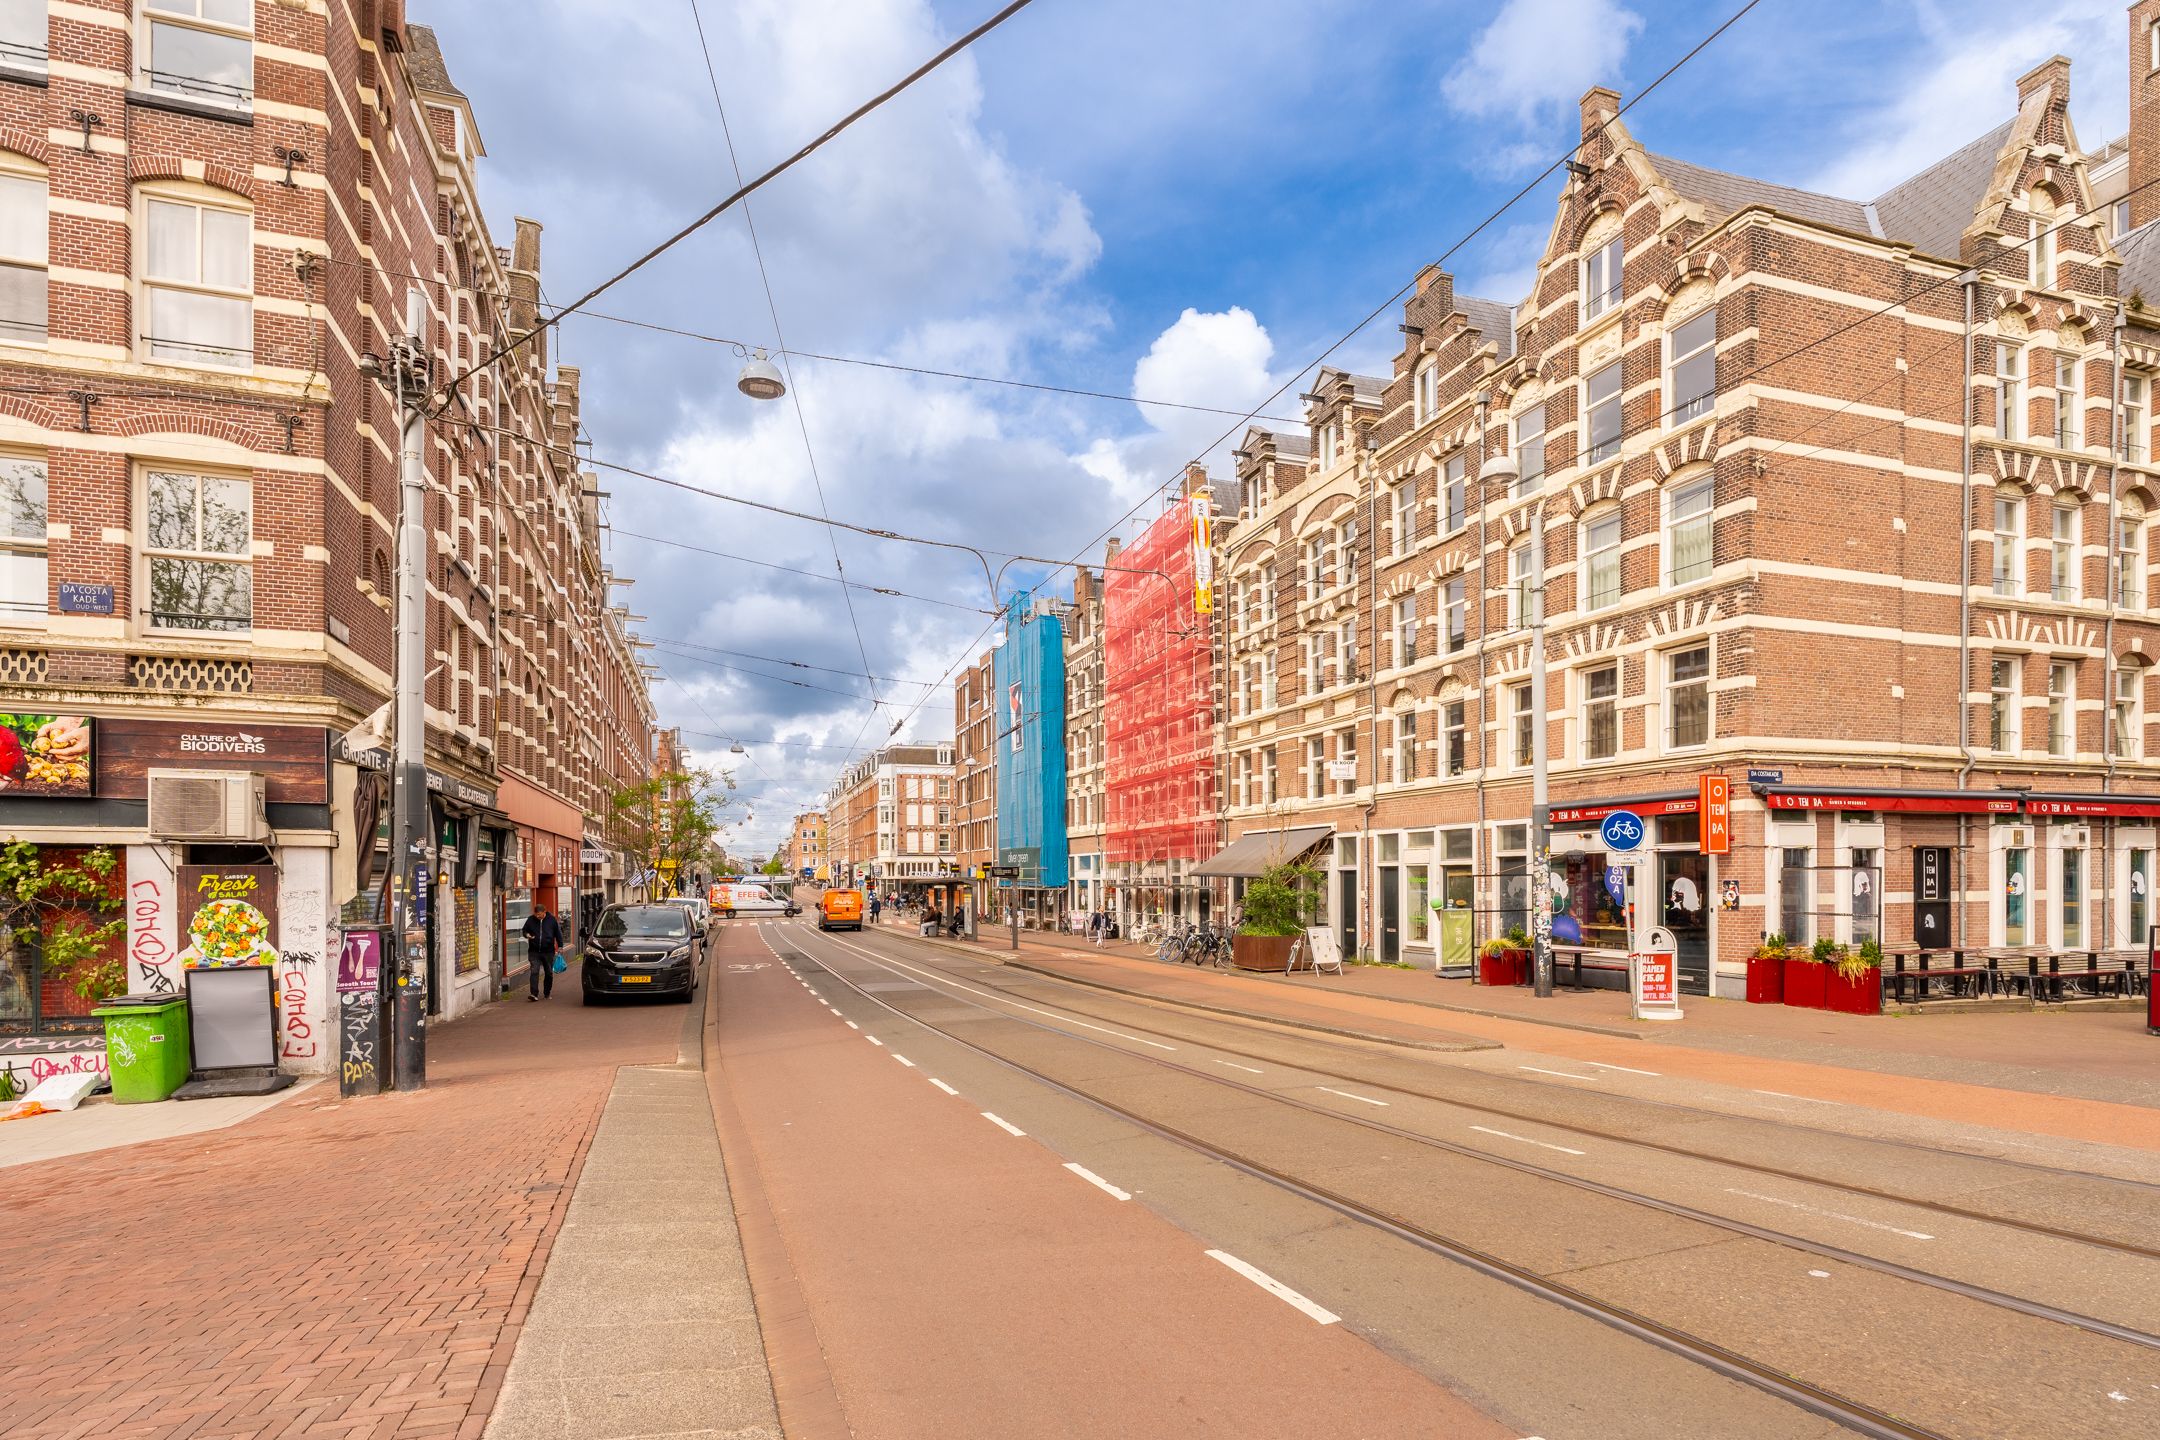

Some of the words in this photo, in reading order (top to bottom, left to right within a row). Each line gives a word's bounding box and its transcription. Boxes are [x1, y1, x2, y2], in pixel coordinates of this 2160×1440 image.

[79, 586, 108, 595] COSTA
[73, 594, 97, 604] KADE
[181, 734, 223, 742] CULTURE
[180, 741, 265, 753] BIODIVERS
[458, 784, 489, 806] DELICATESSEN
[1713, 785, 1723, 797] O
[581, 850, 603, 859] NOOCH
[1927, 854, 1934, 862] O
[197, 874, 259, 893] Fresh
[218, 890, 248, 898] SALAD
[1613, 885, 1620, 894] A
[1642, 955, 1655, 964] ALL
[1642, 964, 1666, 973] RAMEN
